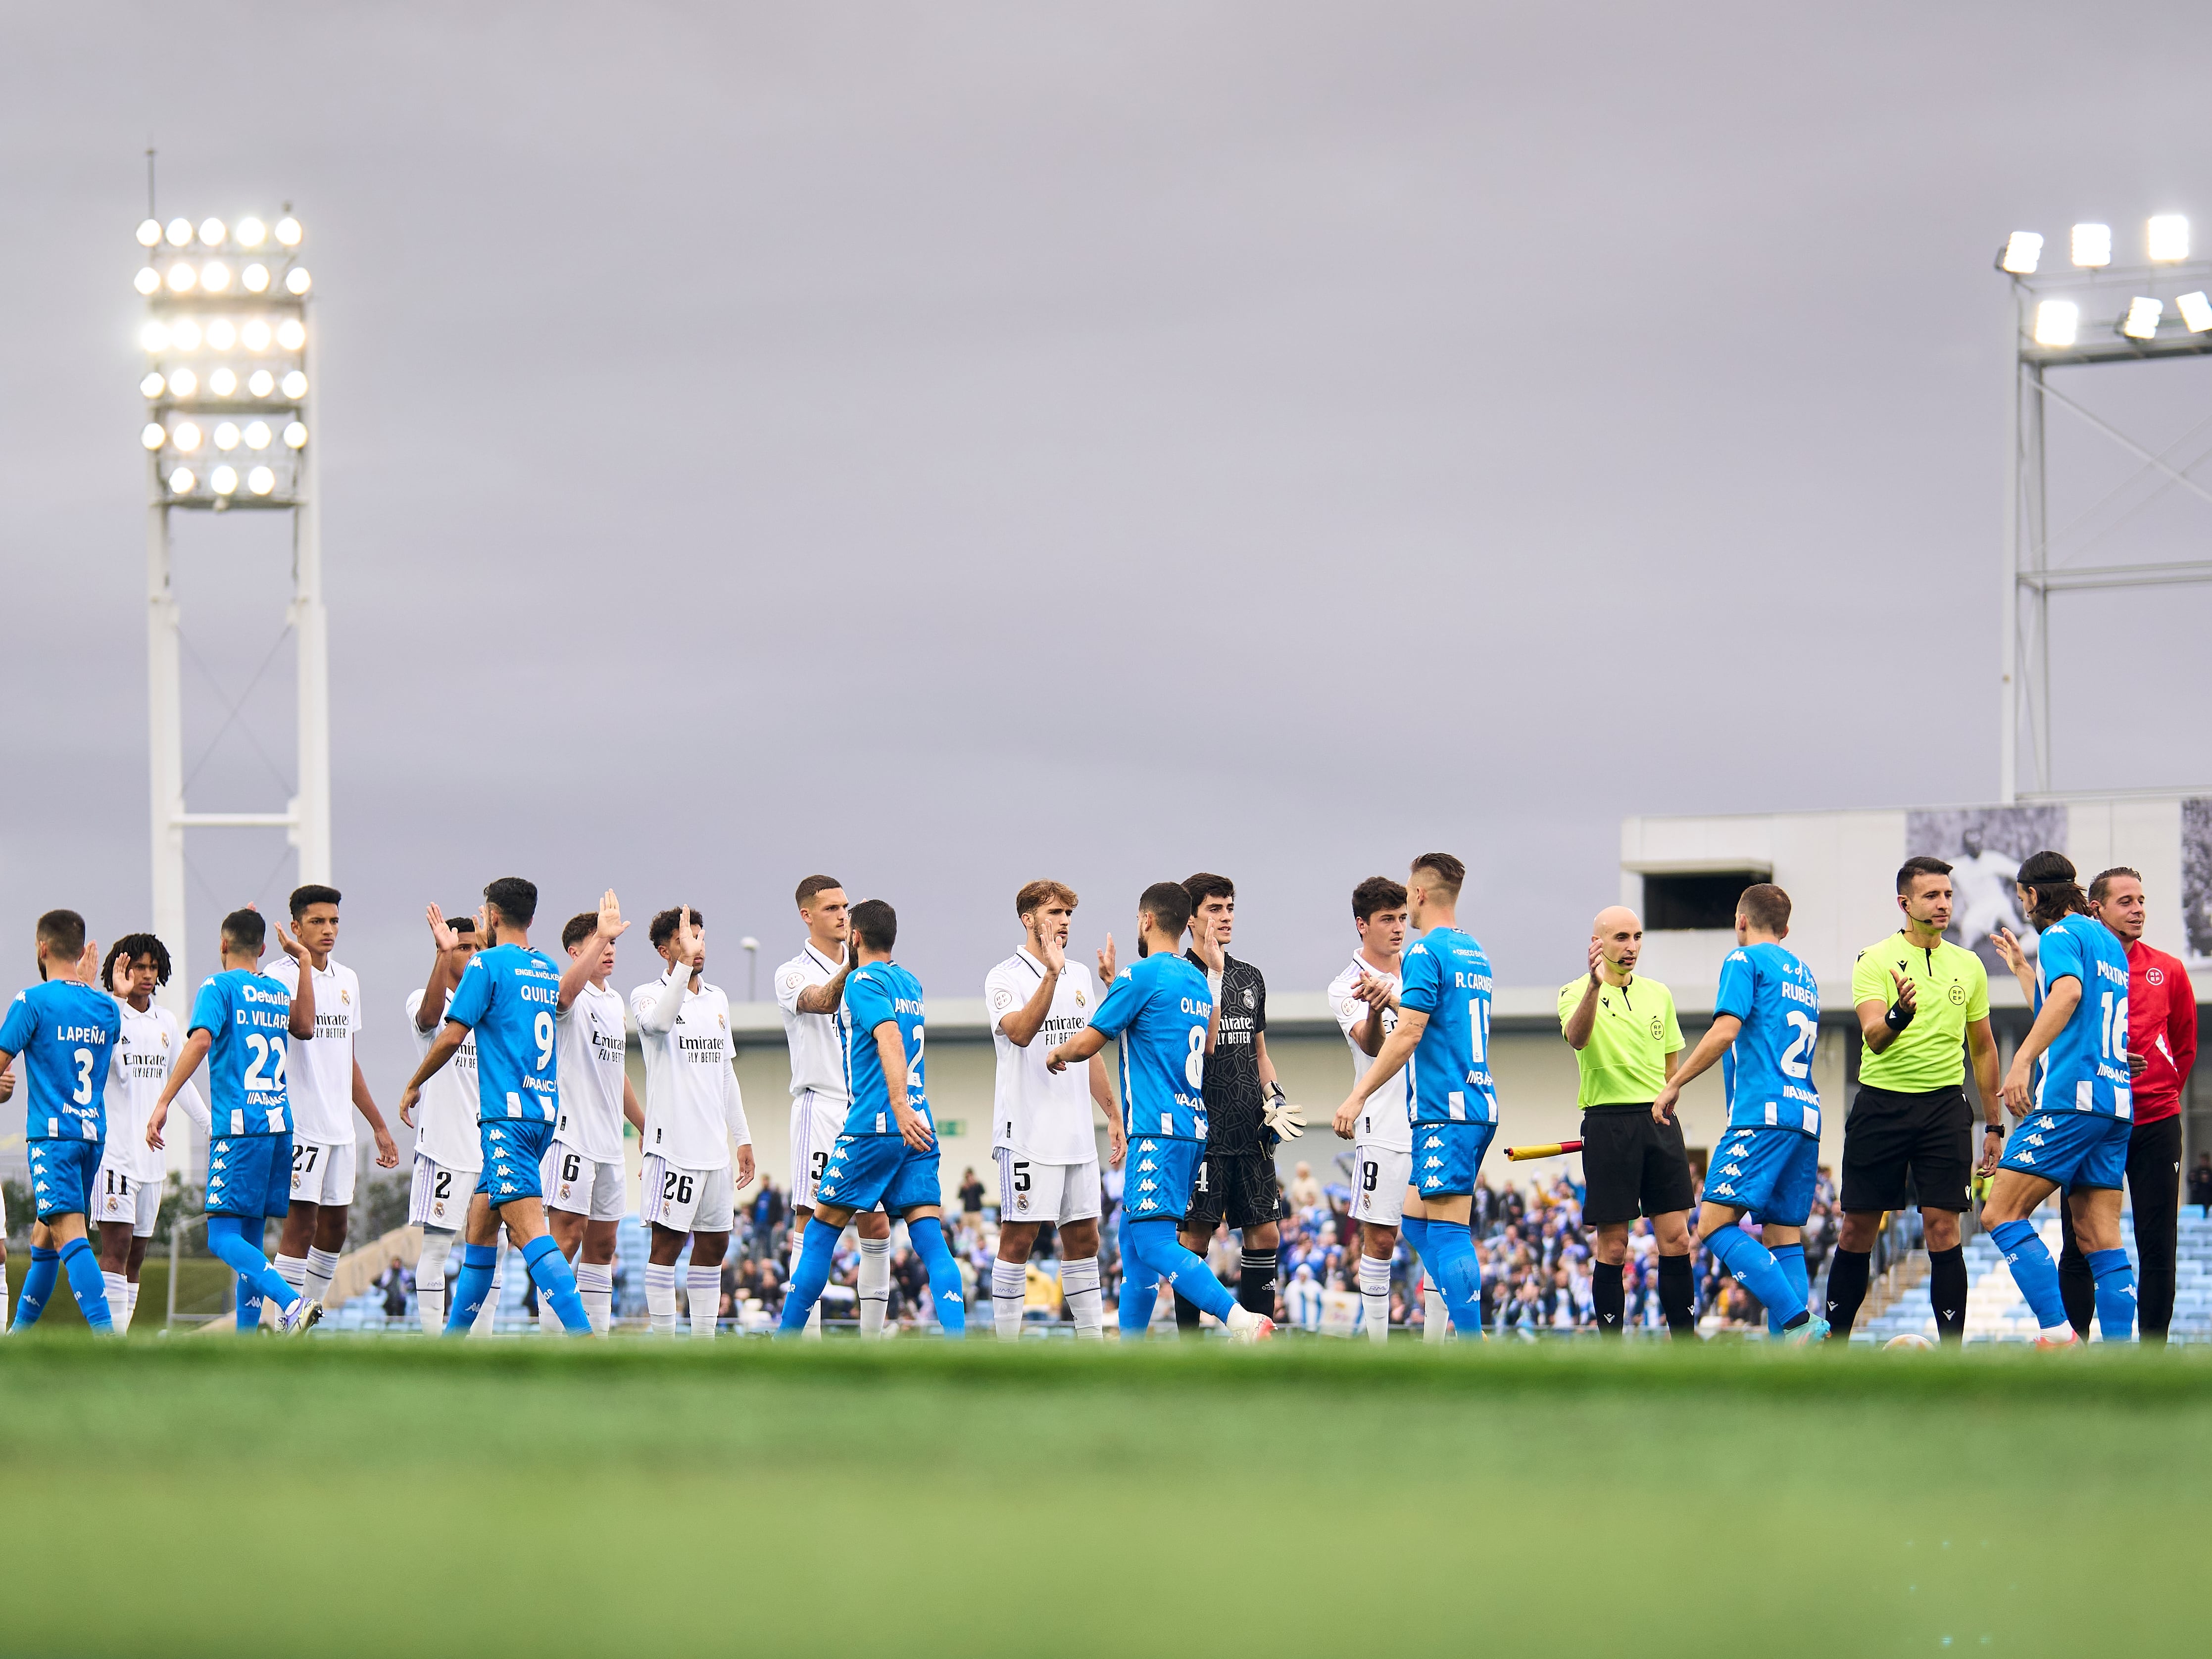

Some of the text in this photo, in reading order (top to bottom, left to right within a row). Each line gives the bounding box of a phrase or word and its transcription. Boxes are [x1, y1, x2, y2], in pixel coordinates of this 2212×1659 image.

[1455, 972, 1467, 988] R.
[1180, 997, 1212, 1021] OLABE
[1782, 981, 1817, 1010] RUBÉN
[236, 1009, 248, 1025] D.
[2101, 991, 2128, 1063] 16
[57, 1025, 105, 1045] LAPEÑA
[326, 1027, 345, 1038] BETTER
[534, 1011, 554, 1071] 9
[679, 1036, 724, 1050] Emirates
[1046, 1033, 1056, 1045] FLY
[1228, 1031, 1250, 1044] BETTER
[123, 1051, 167, 1067] Emirates
[244, 1033, 287, 1092] 22
[455, 1056, 467, 1068] FLY
[688, 1052, 721, 1063] FLY BETTER
[907, 1025, 925, 1087] 2
[1185, 1025, 1206, 1089] 8
[73, 1048, 94, 1105] 3
[133, 1067, 162, 1078] FLY BETTER
[293, 1145, 319, 1172] 27
[562, 1154, 581, 1182] 6
[811, 1152, 828, 1180] 3
[106, 1170, 127, 1195] 11
[435, 1171, 451, 1199] 2
[662, 1171, 693, 1204] 26
[1014, 1162, 1031, 1191] 5
[1363, 1161, 1378, 1191] 8
